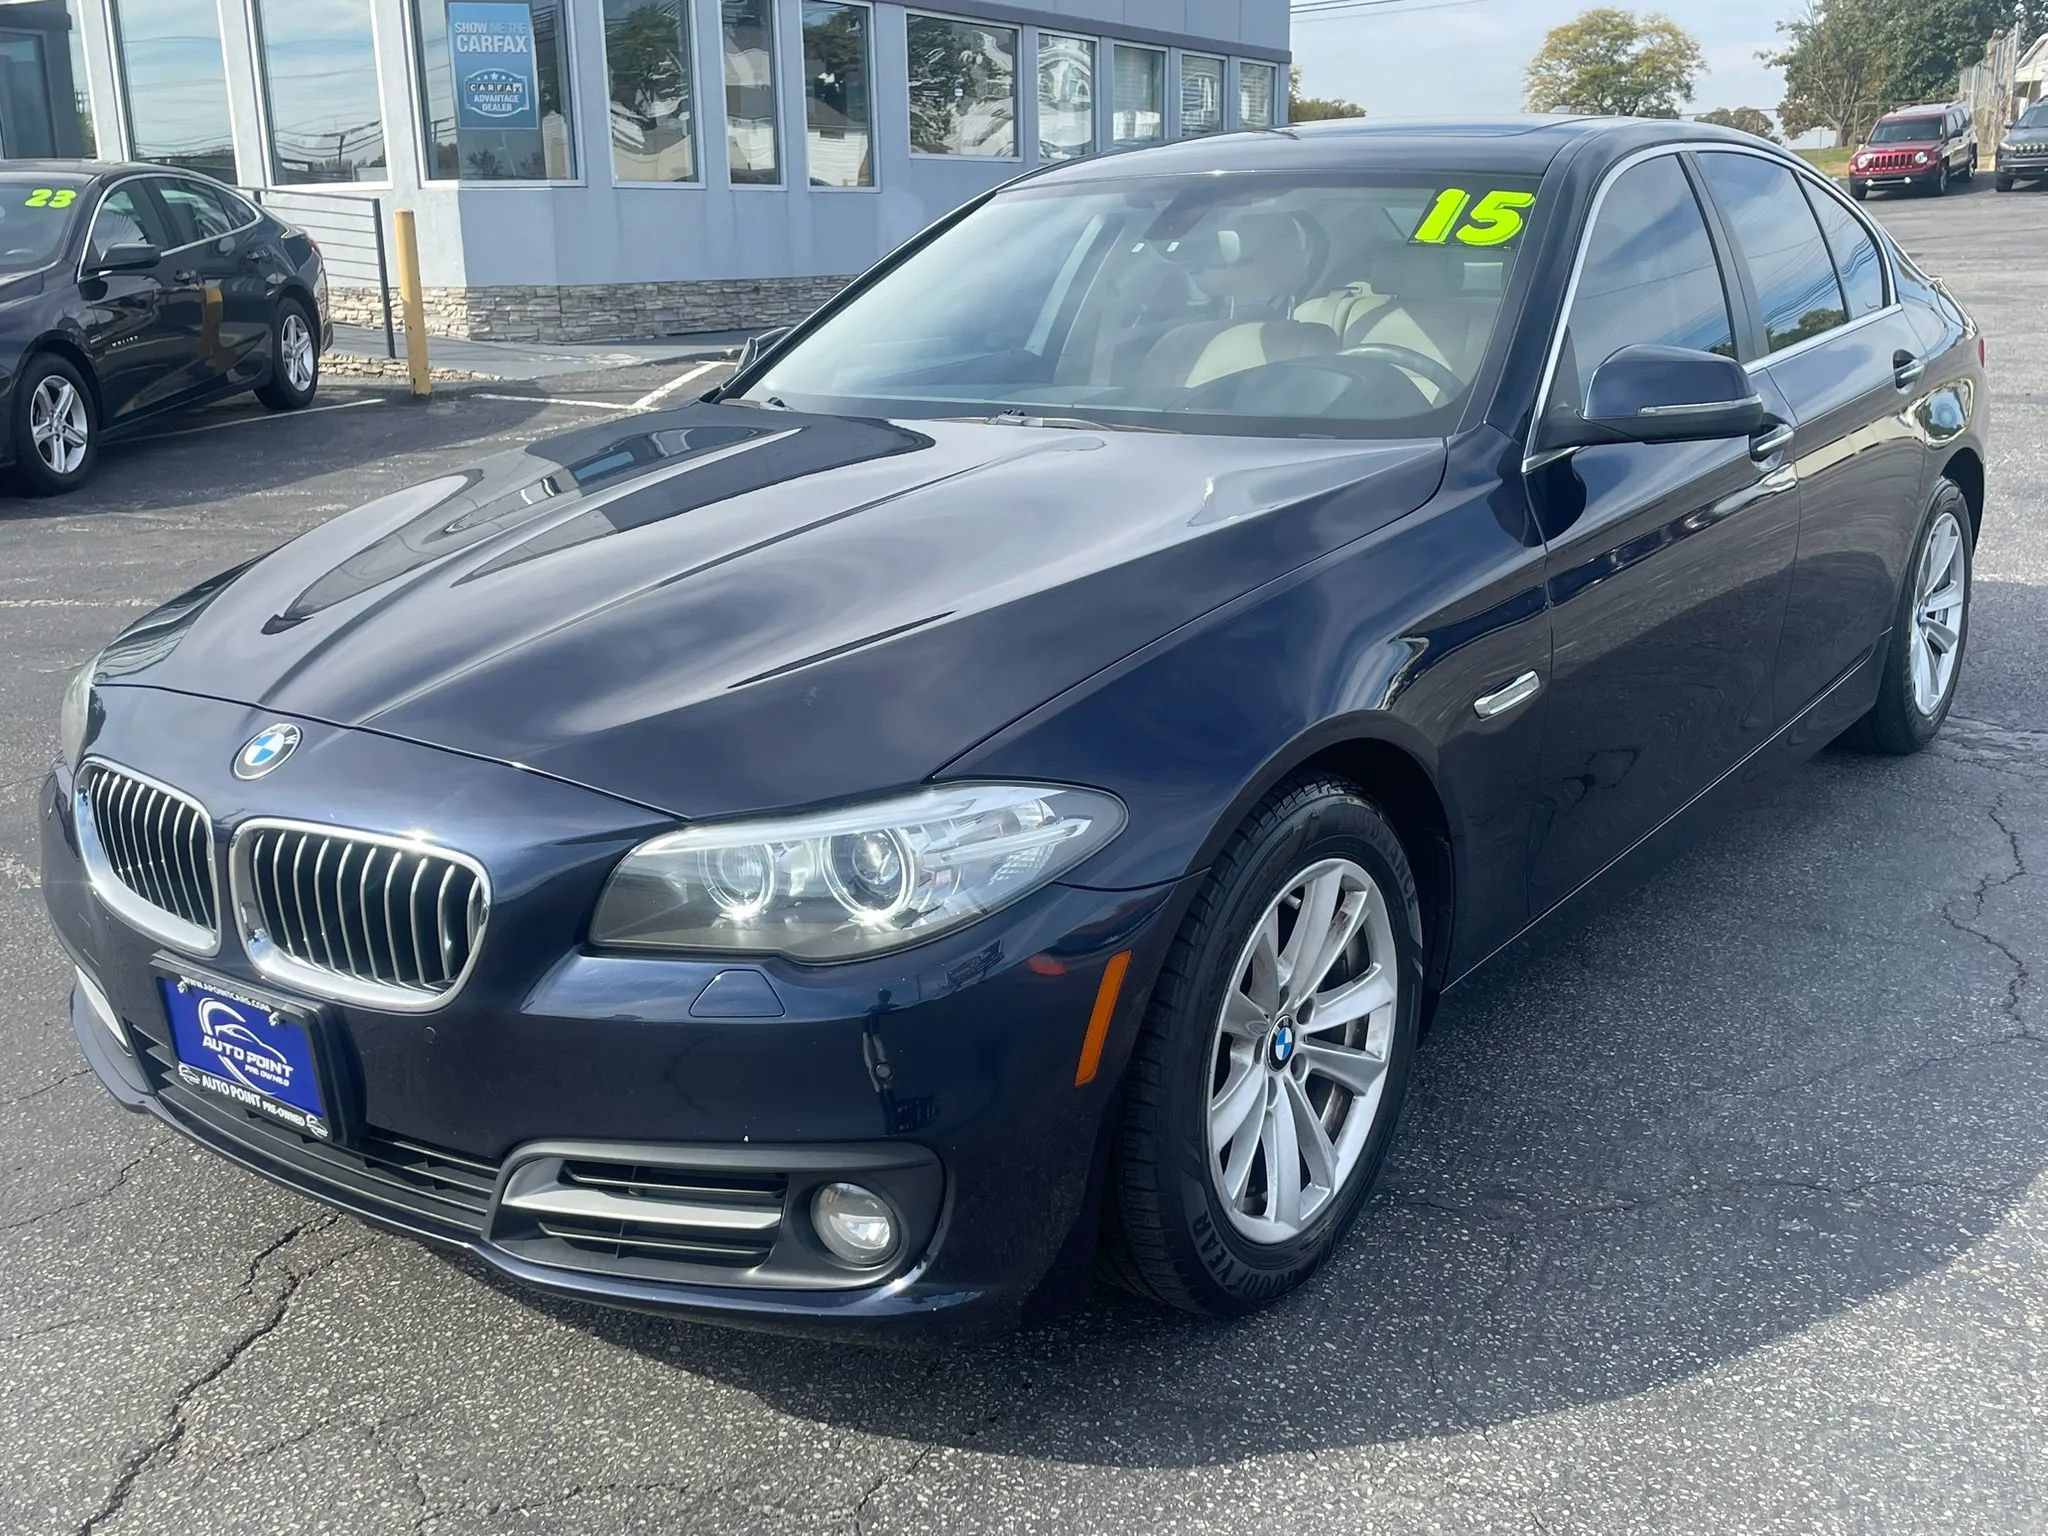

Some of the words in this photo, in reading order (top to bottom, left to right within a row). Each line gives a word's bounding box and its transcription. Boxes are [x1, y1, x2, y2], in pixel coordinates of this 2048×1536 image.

[455, 22, 488, 33] SHOW
[456, 34, 528, 53] CARFAX
[470, 83, 522, 93] CARFAX
[473, 94, 520, 103] ADVANTAGE
[482, 103, 513, 112] DEALER
[25, 188, 77, 208] 23
[1414, 188, 1536, 246] 15
[202, 1035, 245, 1061] AUTO
[246, 1050, 294, 1078] POINT
[202, 1075, 230, 1095] AUTO
[230, 1085, 260, 1108] POINT
[262, 1100, 305, 1127] PRE-OWNED
